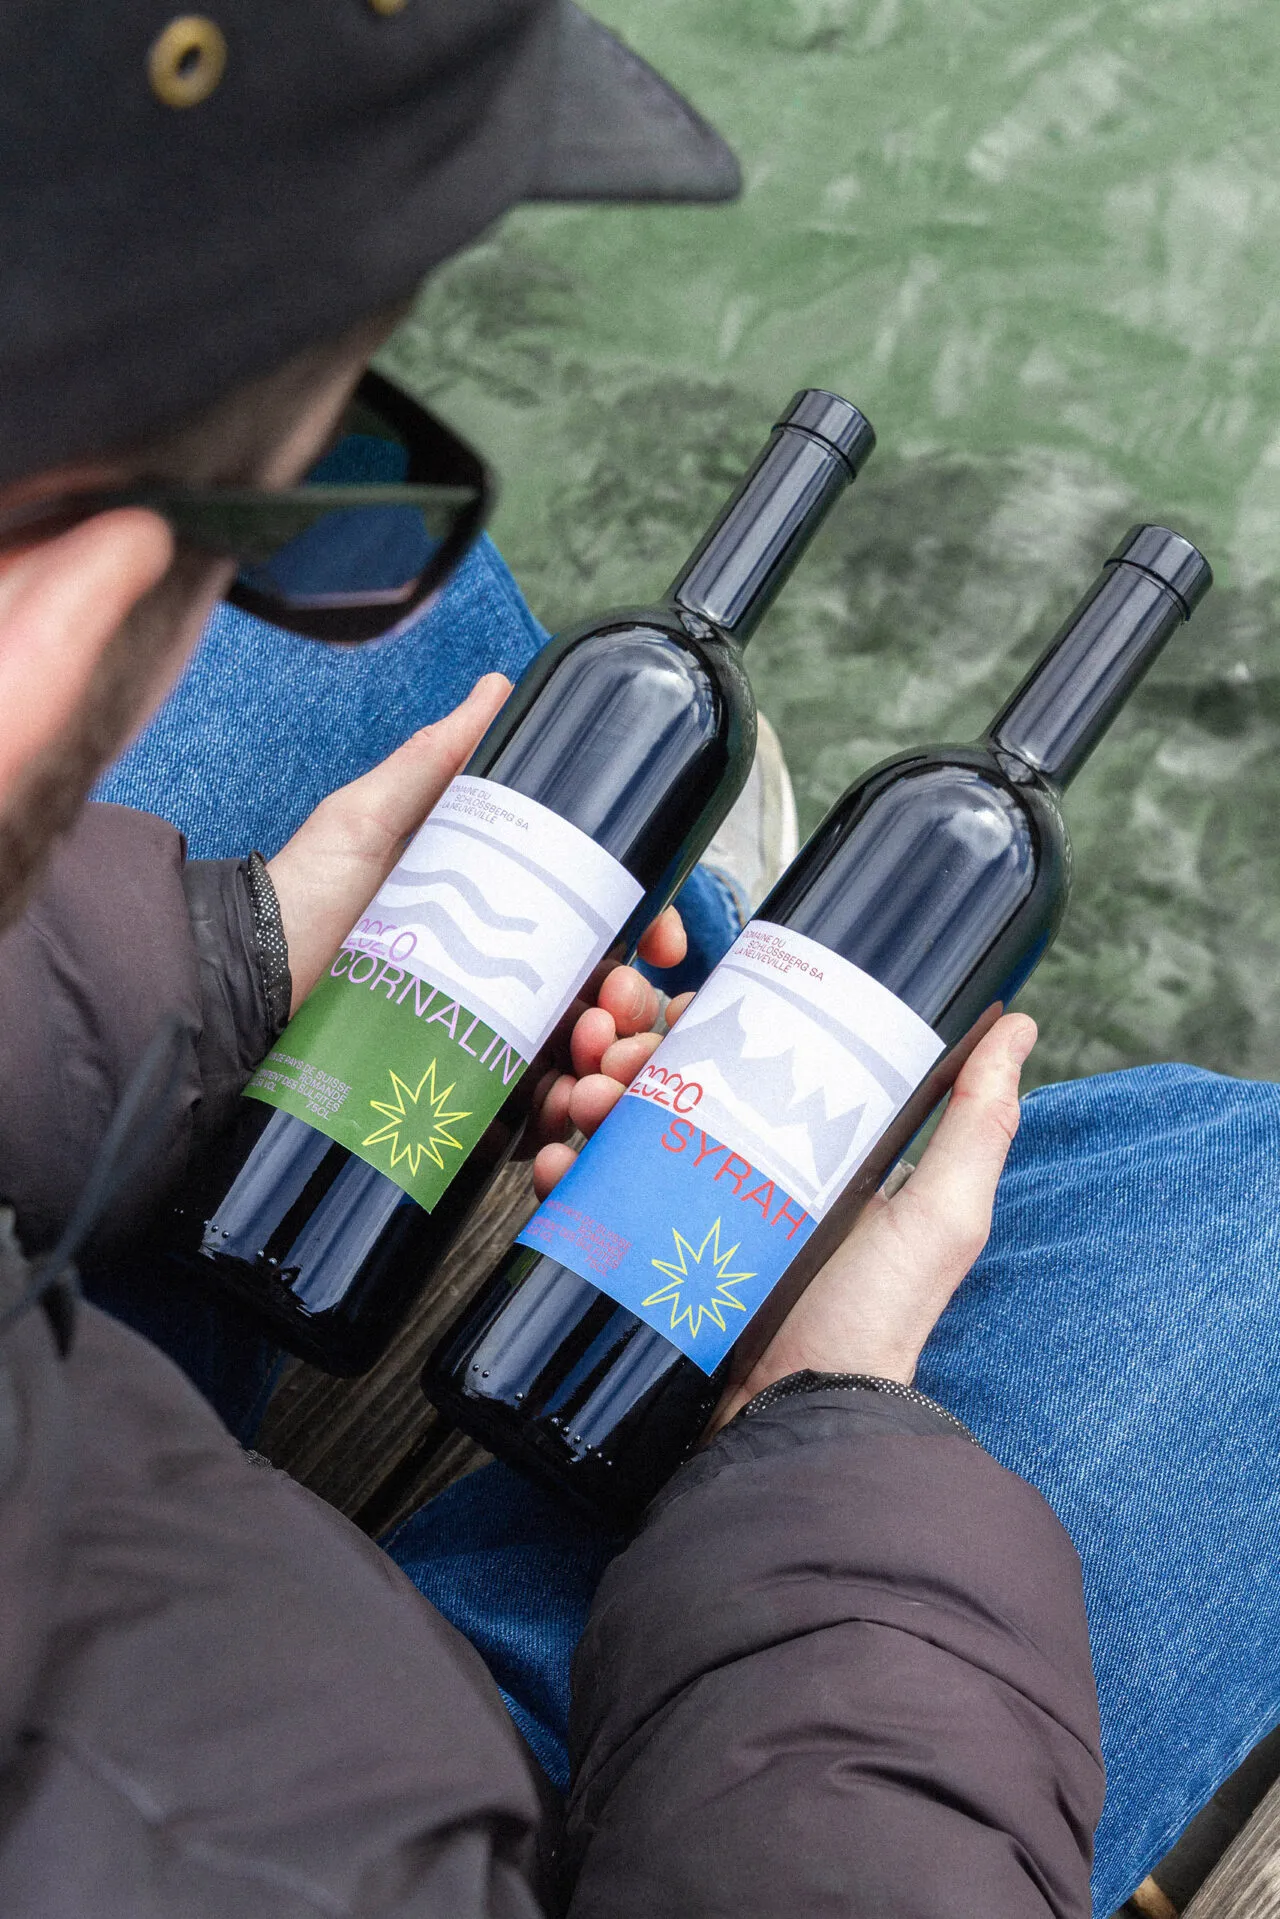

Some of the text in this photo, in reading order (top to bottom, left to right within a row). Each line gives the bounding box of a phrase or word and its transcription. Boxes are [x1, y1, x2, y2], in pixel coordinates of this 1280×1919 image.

[477, 790, 492, 800] DU
[449, 802, 497, 825] NEUVEVILLE
[455, 794, 529, 830] SCHLOSSBERG SA
[772, 936, 787, 948] DU
[742, 948, 792, 974] NEUVEVILLE
[748, 940, 824, 981] SCHLOSSBERG SA
[330, 948, 524, 1086] CORNALIN
[284, 1056, 304, 1070] PAYS
[303, 1064, 317, 1077] DE
[316, 1070, 352, 1095] SUISSE
[299, 1073, 347, 1105] ROMANDE
[297, 1084, 340, 1113] SULFITES
[305, 1100, 330, 1120] 75CL
[661, 1117, 809, 1241] SYRAH
